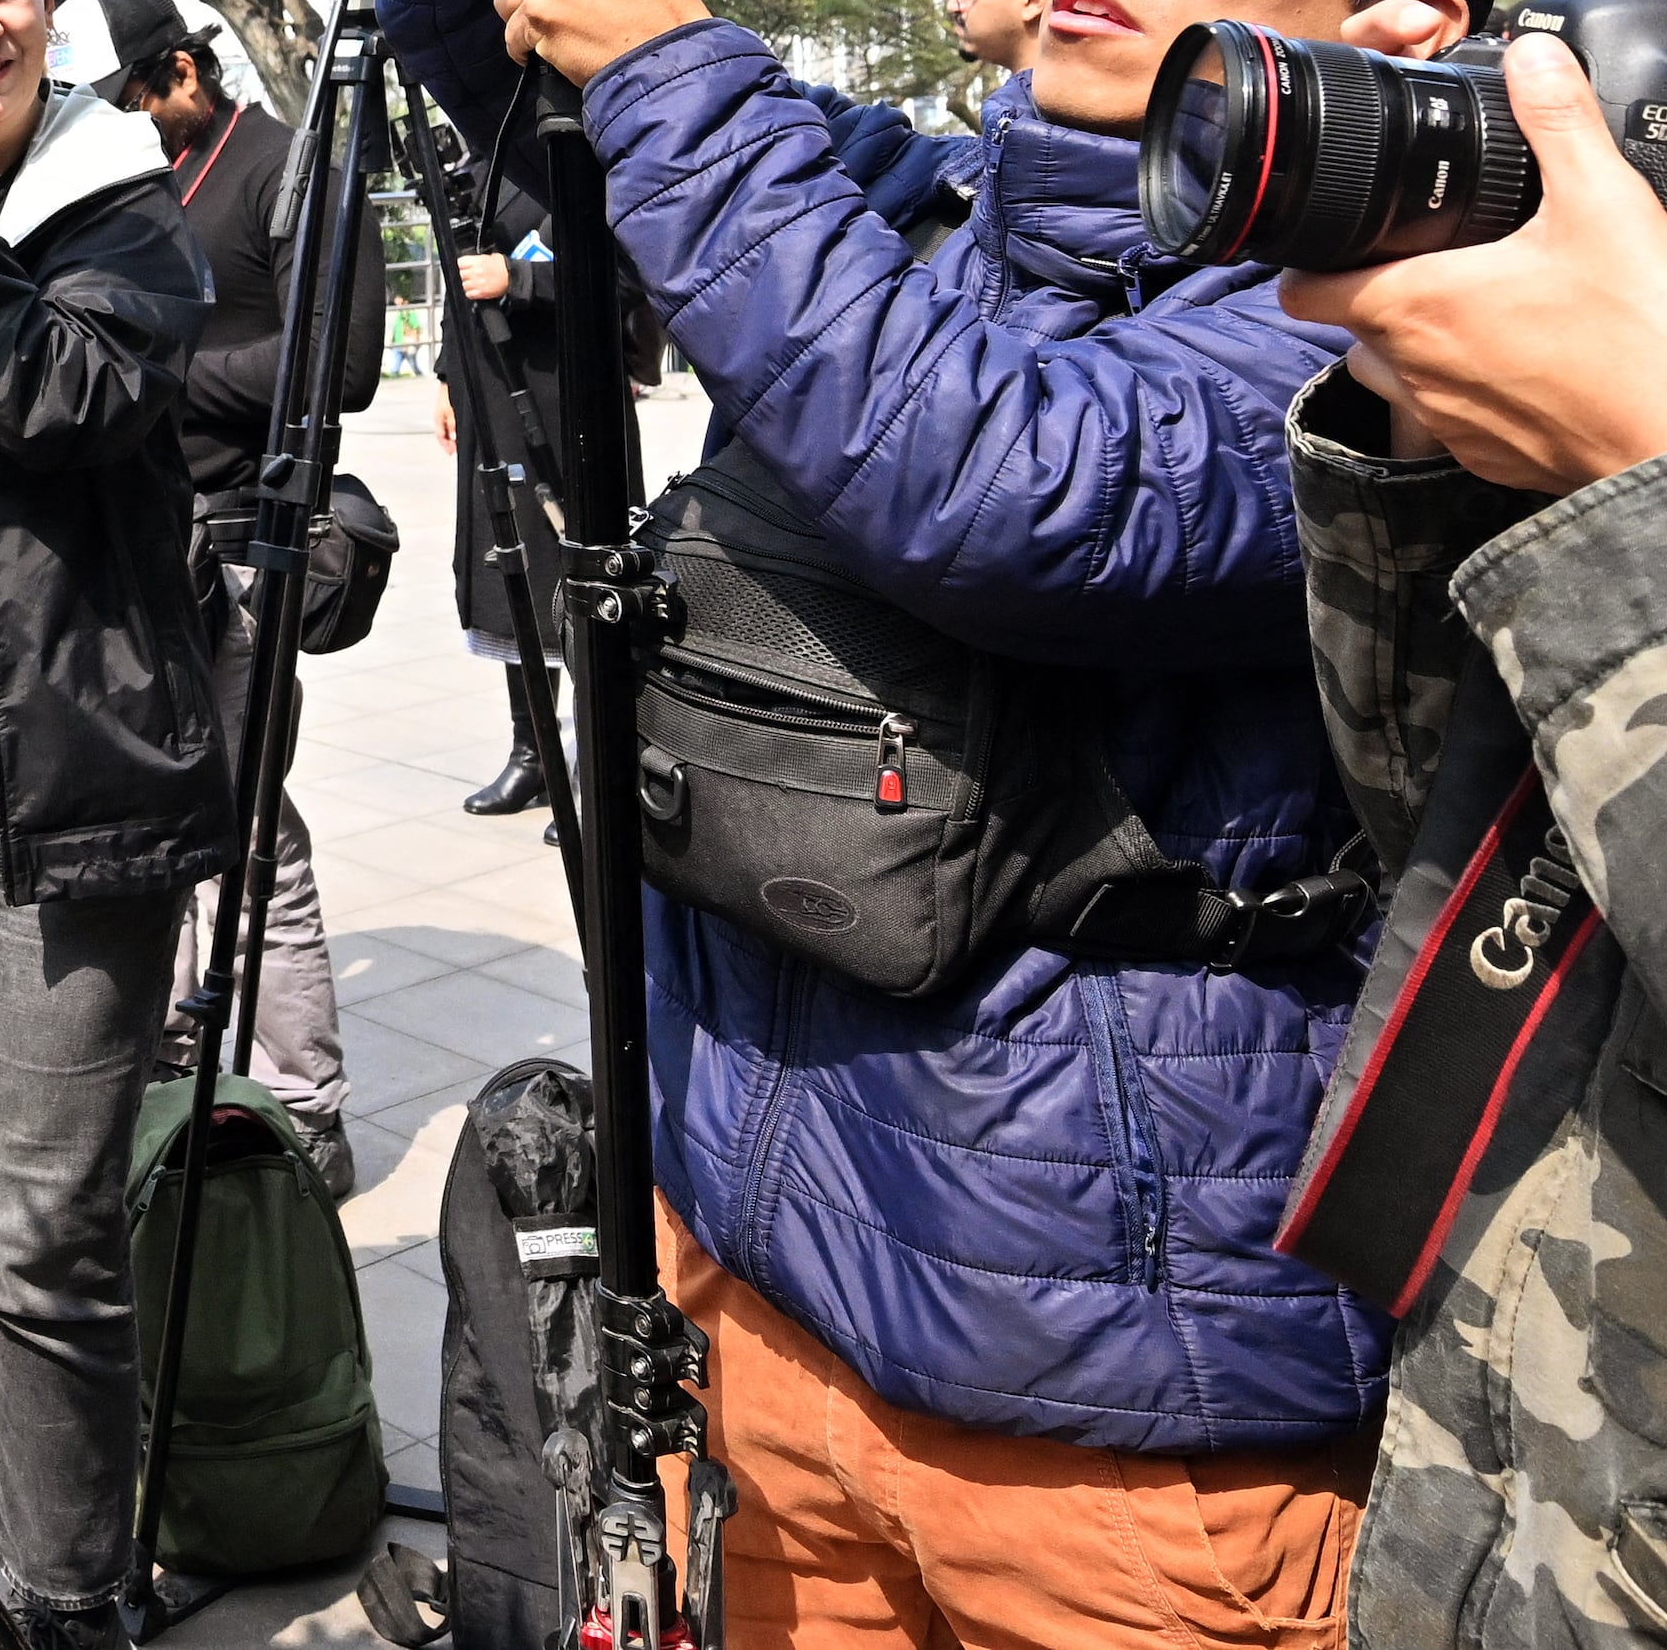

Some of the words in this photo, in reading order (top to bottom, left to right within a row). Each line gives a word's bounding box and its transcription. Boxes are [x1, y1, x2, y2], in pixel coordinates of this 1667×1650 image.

[1518, 8, 1565, 32] Canon
[1278, 61, 1292, 95] CANON
[1428, 160, 1450, 209] Canon
[1470, 824, 1580, 990] Cano
[545, 1232, 583, 1246] PRESS
